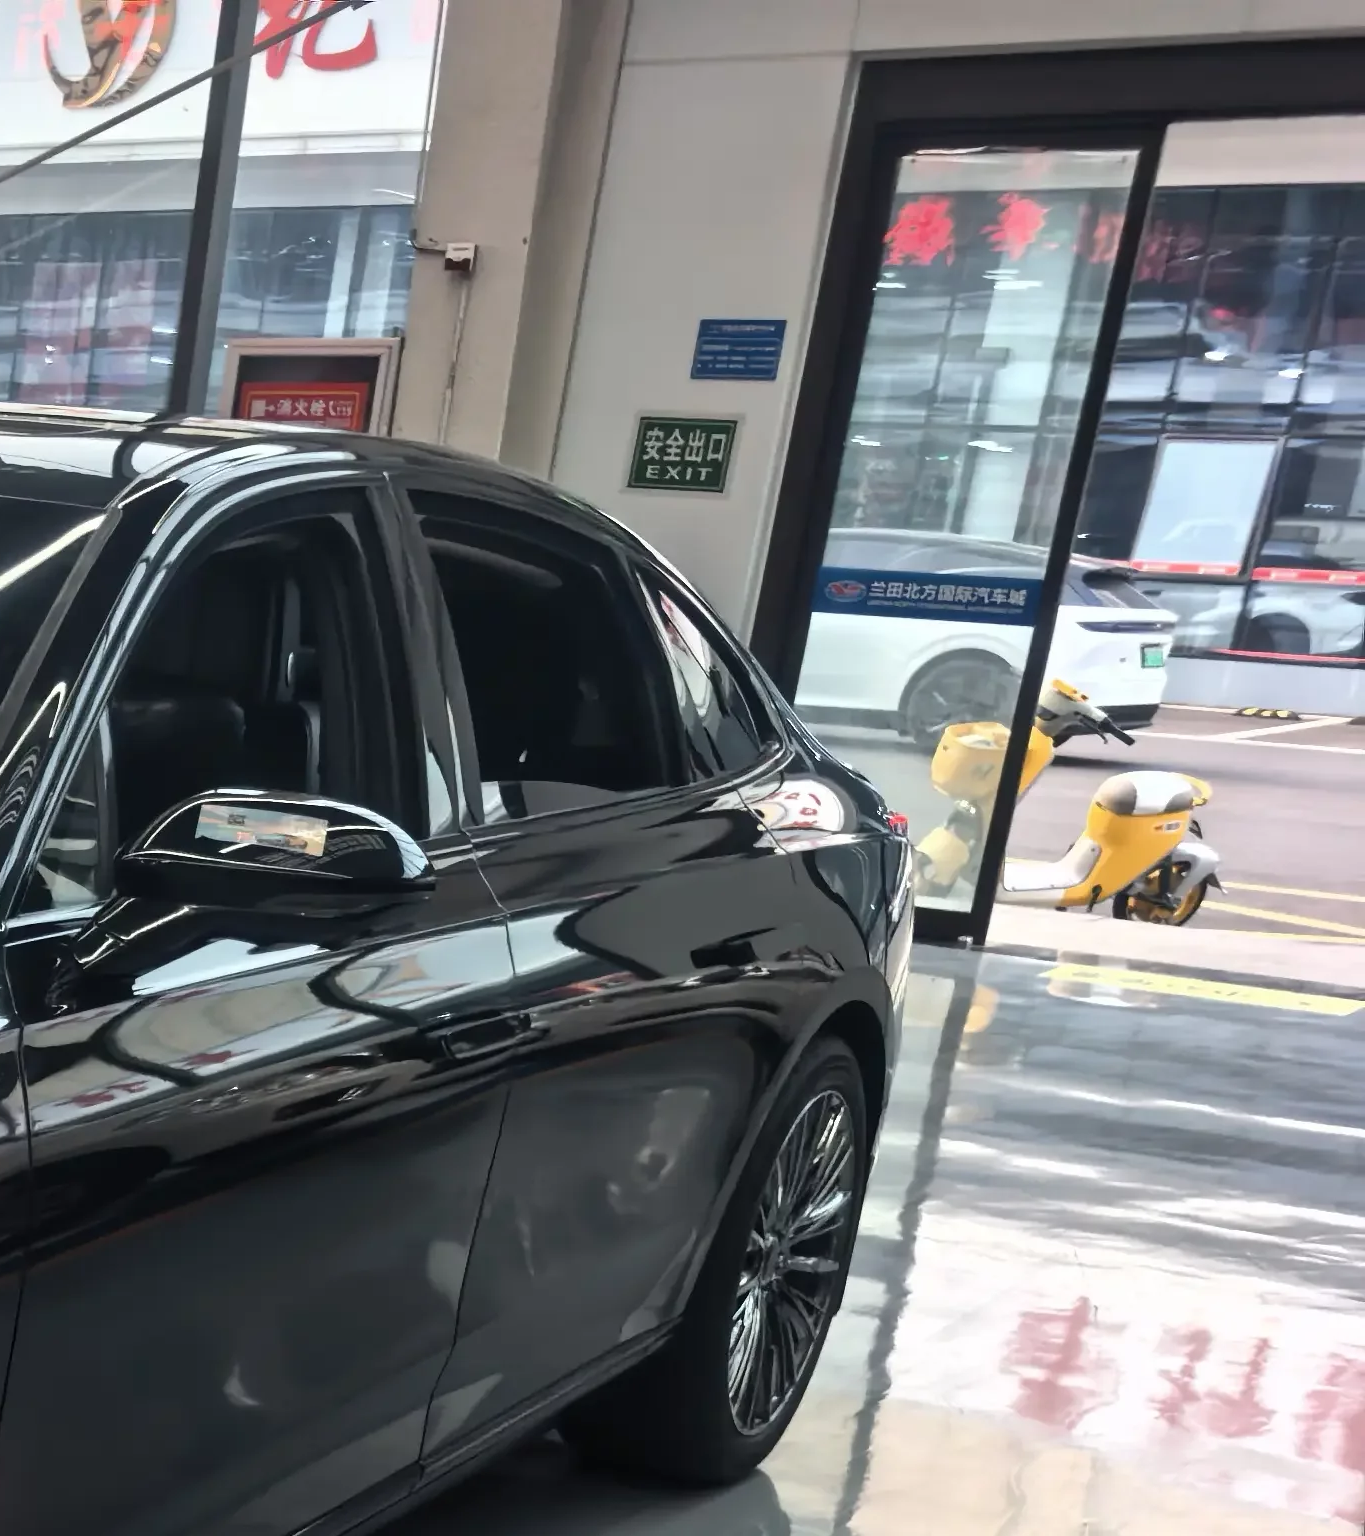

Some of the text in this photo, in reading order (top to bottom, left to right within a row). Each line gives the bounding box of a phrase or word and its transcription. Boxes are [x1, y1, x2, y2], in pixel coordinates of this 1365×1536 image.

[642, 427, 726, 463] 安全出口
[646, 465, 713, 481] EXIT
[868, 581, 1028, 607] 兰田北方国际汽车城
